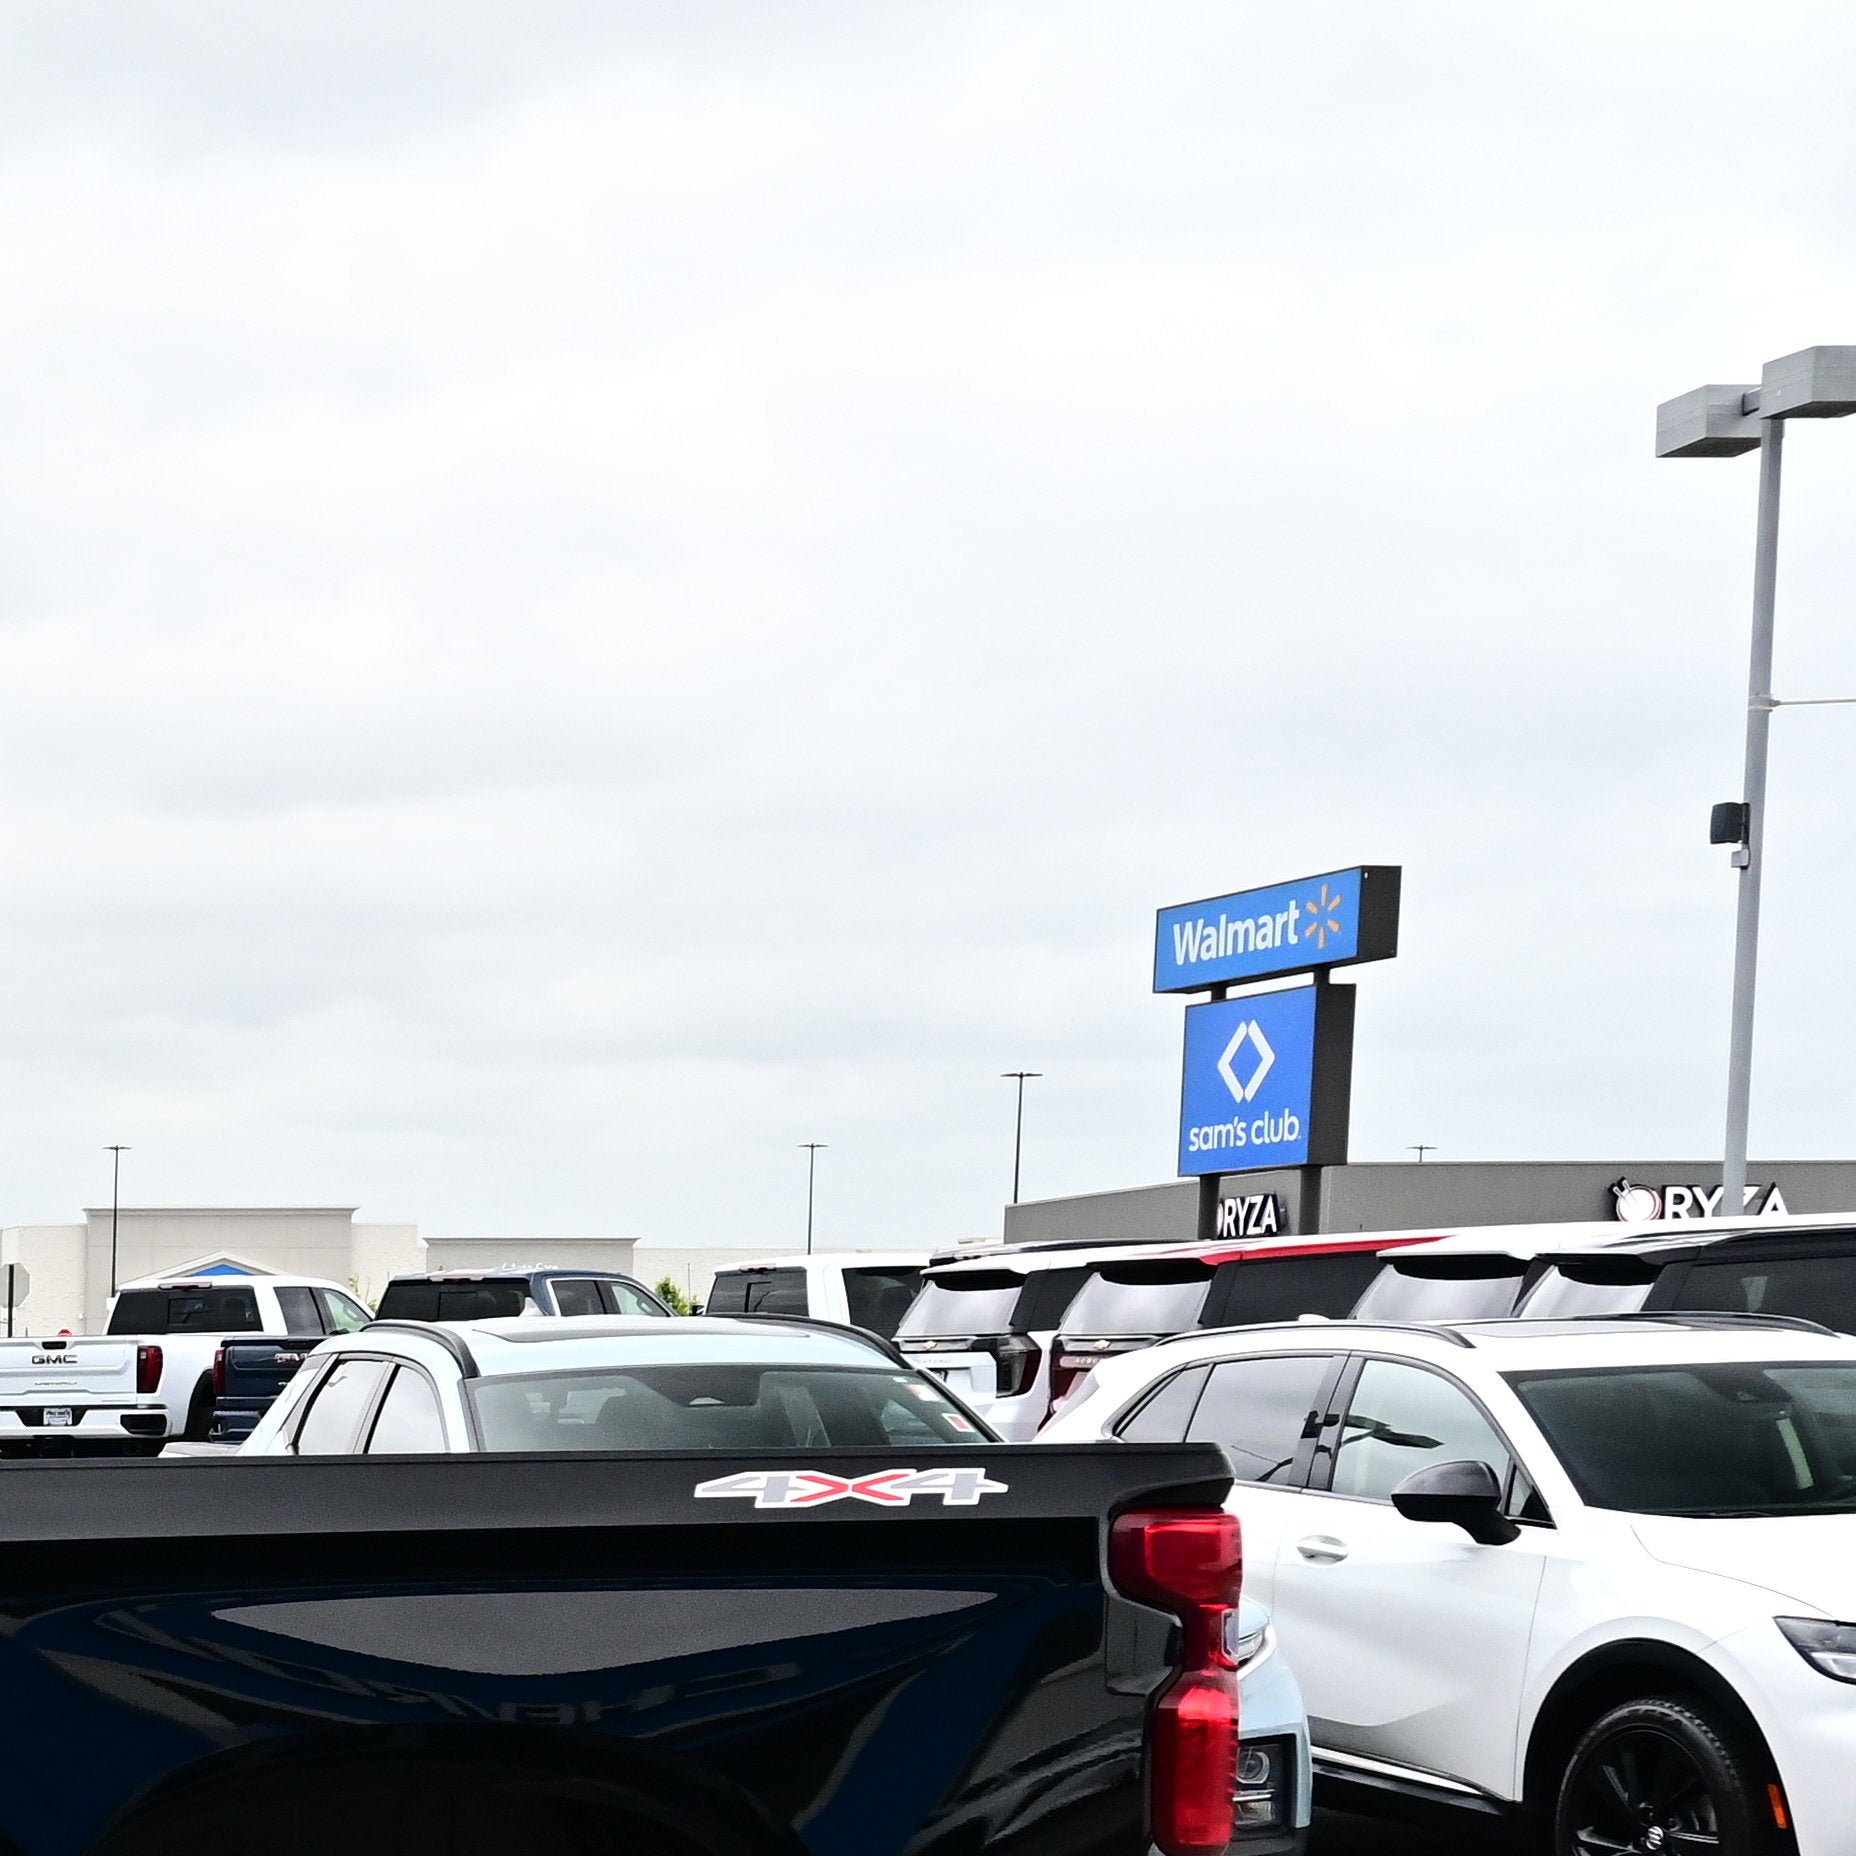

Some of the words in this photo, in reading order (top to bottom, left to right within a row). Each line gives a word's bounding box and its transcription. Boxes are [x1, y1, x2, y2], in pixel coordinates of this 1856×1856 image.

[1173, 900, 1300, 965] Walmart
[1189, 1116, 1247, 1151] sam's
[1251, 1108, 1300, 1144] club
[1223, 1194, 1277, 1238] RYZA
[32, 1355, 77, 1364] GMC
